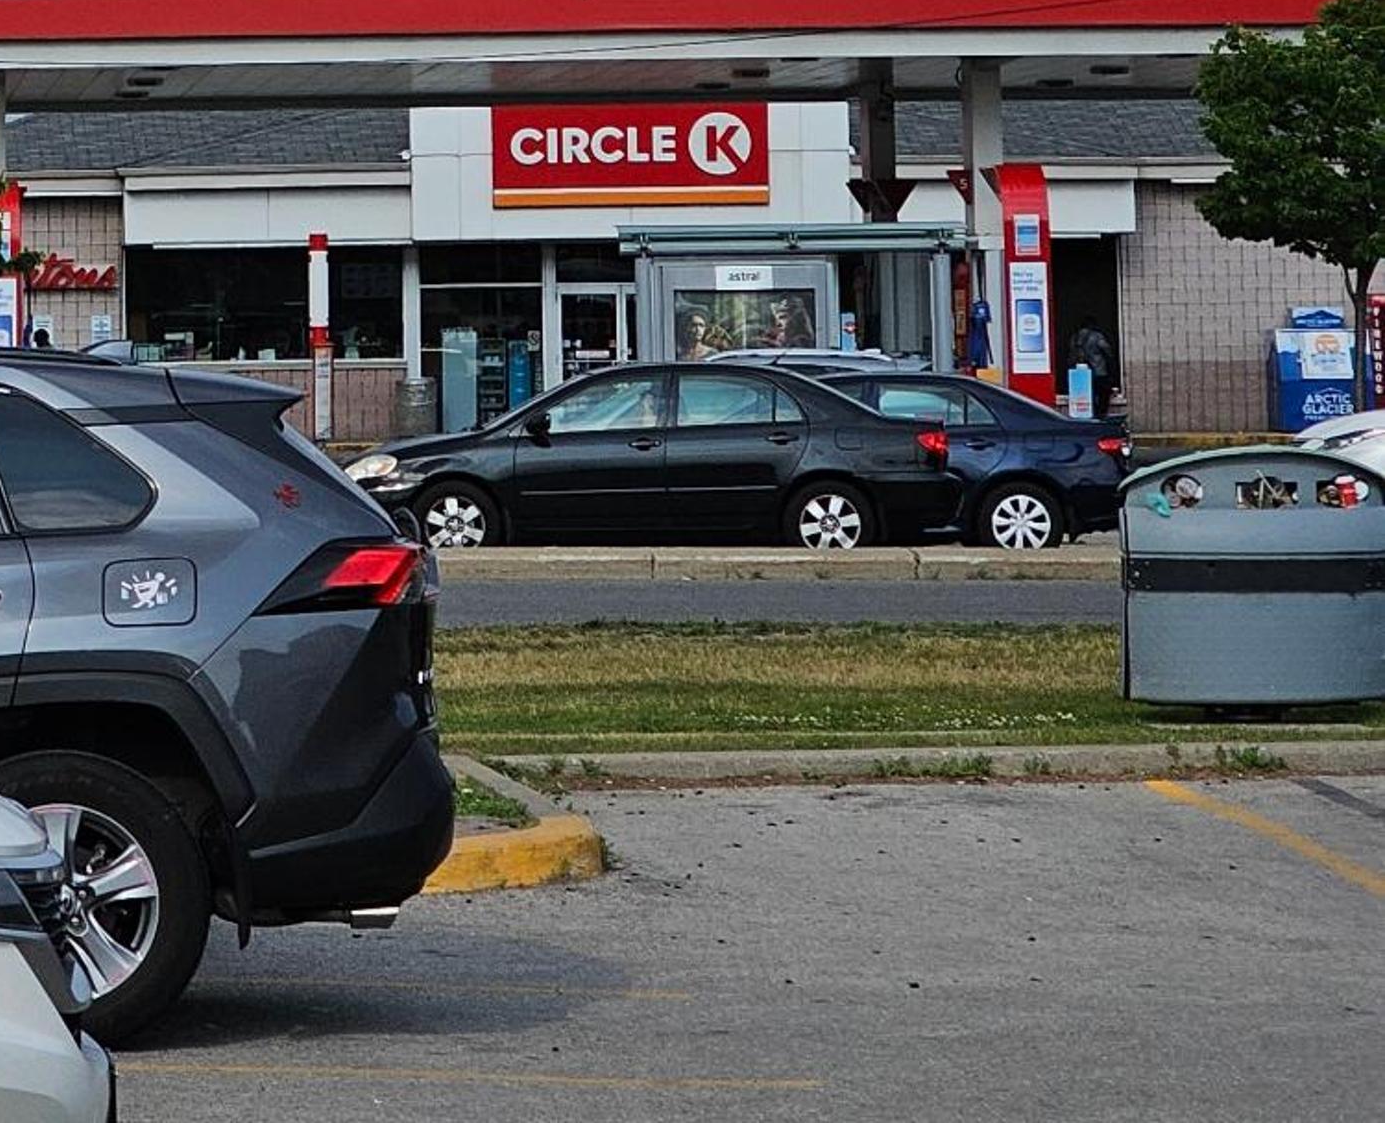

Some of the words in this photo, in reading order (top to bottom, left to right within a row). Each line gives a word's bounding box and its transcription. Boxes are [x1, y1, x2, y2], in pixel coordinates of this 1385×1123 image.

[510, 126, 677, 166] CIRCLE
[727, 271, 761, 282] astral
[1304, 393, 1351, 404] ARCTIC
[1301, 403, 1355, 415] GLACIER
